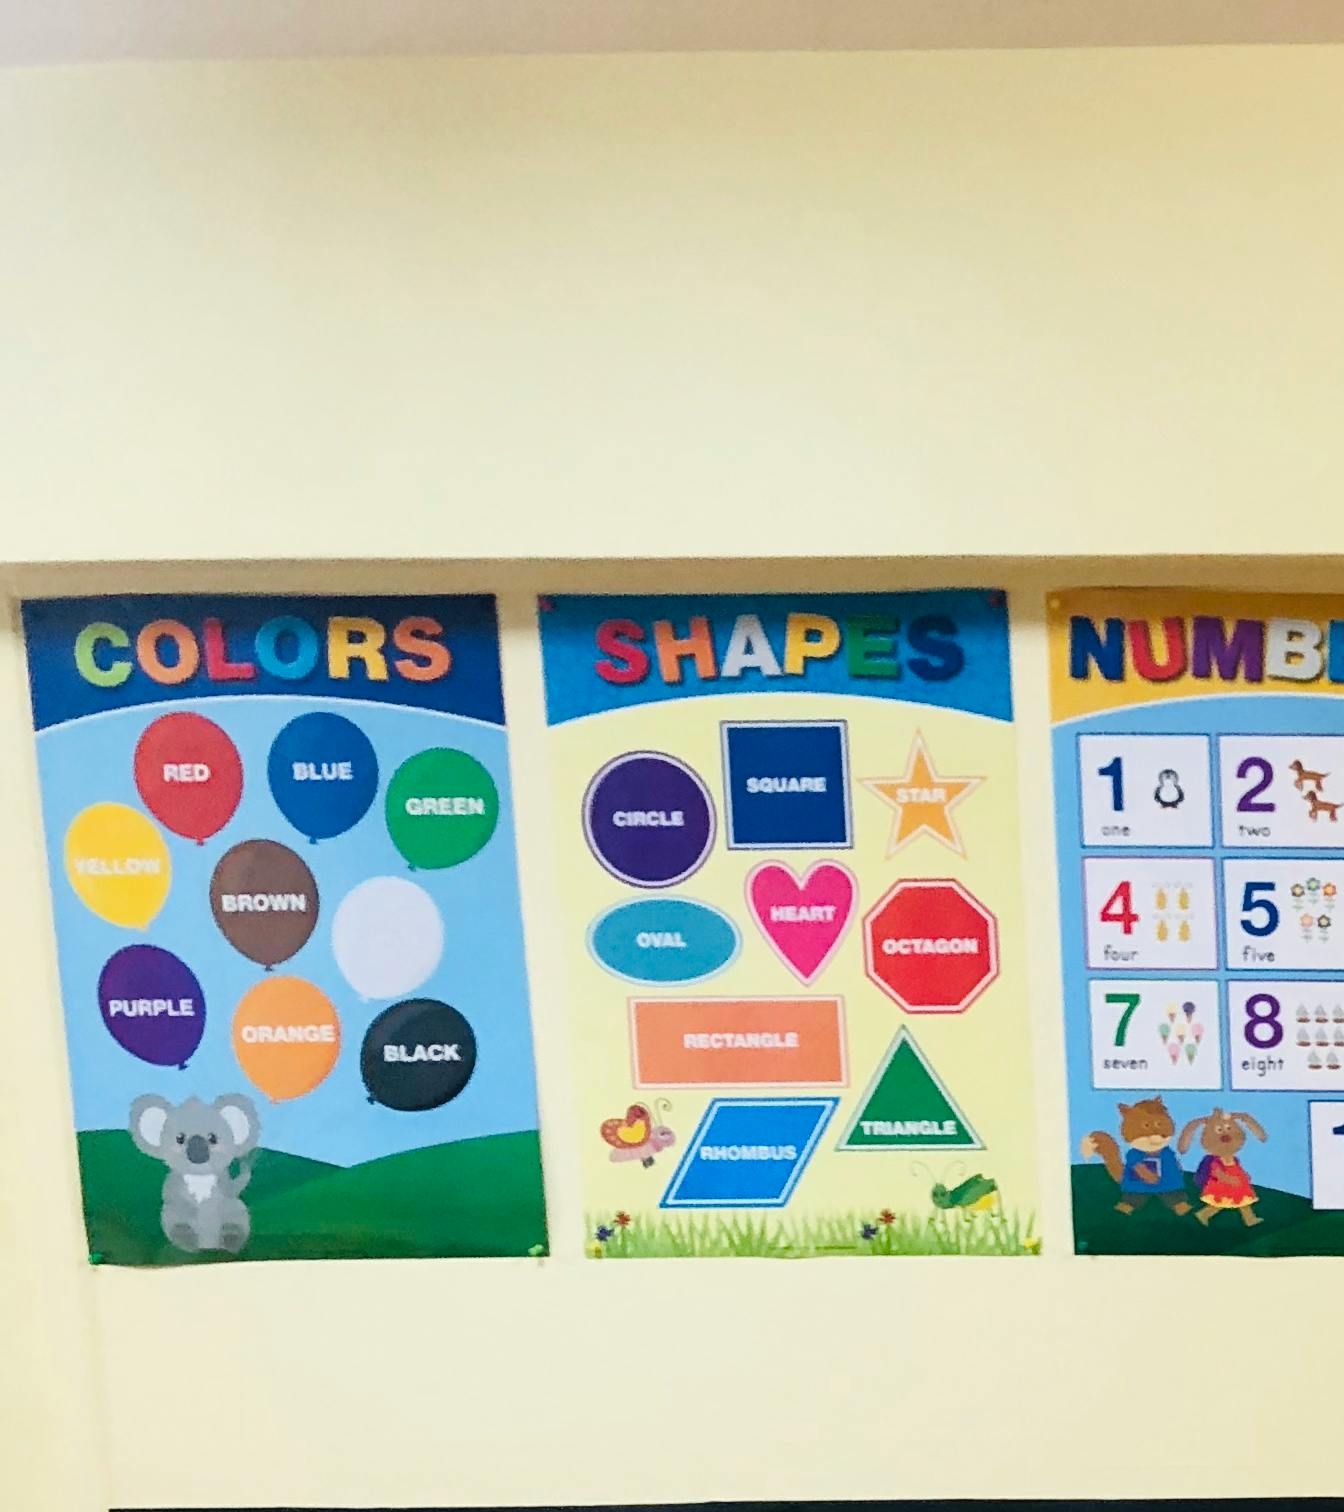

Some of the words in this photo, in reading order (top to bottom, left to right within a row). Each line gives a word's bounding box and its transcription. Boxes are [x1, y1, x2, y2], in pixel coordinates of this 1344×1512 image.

[74, 615, 453, 687] COLORS
[594, 613, 965, 685] SHAPES
[163, 764, 210, 780] RED
[293, 762, 353, 780] BLUE
[746, 777, 827, 793] SQUARE
[1098, 757, 1125, 811] 1
[1236, 757, 1275, 813] 2
[896, 786, 945, 802] STAR
[406, 797, 485, 816] GREEN
[613, 810, 684, 827] CIRCLE
[1102, 825, 1131, 837] one
[1238, 825, 1271, 837] two
[75, 856, 160, 874] YELLOW
[222, 894, 306, 912] BROWN
[1099, 881, 1139, 935] 4
[1240, 881, 1279, 936] 5
[770, 904, 835, 922] HEART
[636, 932, 686, 948] OVAL
[882, 937, 978, 955] OCTAGON
[1103, 946, 1139, 962] four
[1243, 947, 1275, 962] five
[109, 999, 194, 1016] PURPLE
[1104, 993, 1141, 1046] 7
[1243, 993, 1283, 1048] 8
[242, 1025, 334, 1043] ORANGE
[684, 1031, 798, 1048] RECTANGLE
[384, 1044, 461, 1062] BLACK
[1104, 1057, 1148, 1070] seven
[1242, 1056, 1284, 1074] eight
[861, 1119, 956, 1136] TRIANGLE
[701, 1144, 797, 1161] RHOMBUS
